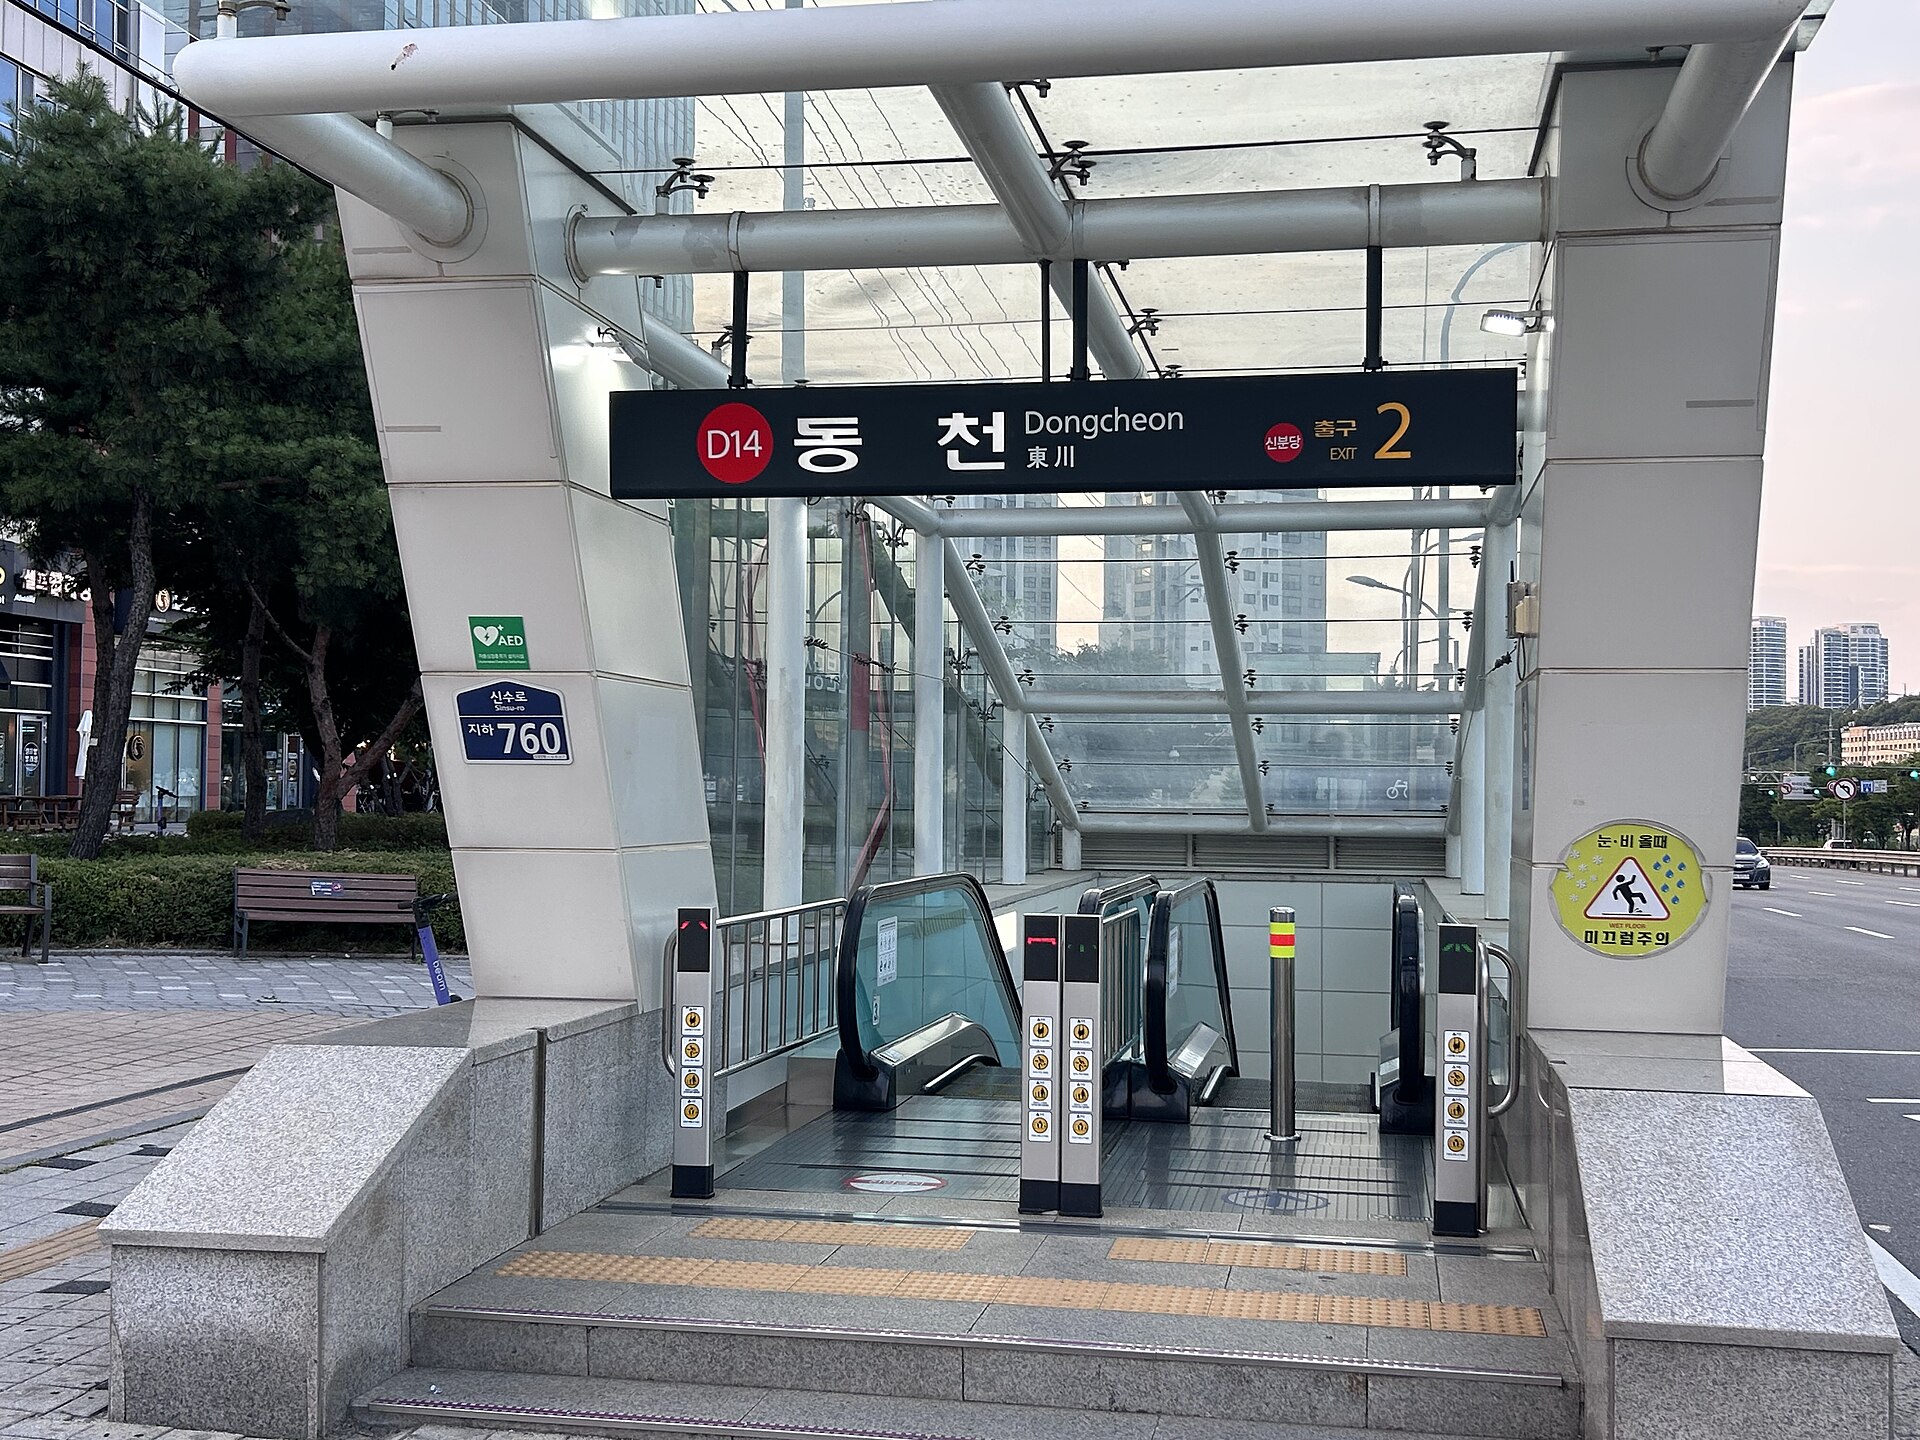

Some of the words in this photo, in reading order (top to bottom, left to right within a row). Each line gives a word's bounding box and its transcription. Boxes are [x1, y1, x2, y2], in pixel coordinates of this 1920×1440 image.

[1025, 406, 1184, 440] Dongcheon
[1314, 420, 1357, 438] 출구
[1374, 402, 1412, 459] 2
[707, 429, 763, 459] D14
[1265, 434, 1301, 451] 신분당
[1026, 445, 1075, 469] 東川
[1330, 447, 1358, 460] EXIT
[498, 635, 524, 646] AED
[490, 690, 528, 704] 신수로
[494, 704, 526, 712] Sinsu-ro
[467, 723, 495, 736] 지하
[497, 722, 561, 754] 760
[1639, 834, 1668, 848] 올때
[432, 960, 446, 991] beam
